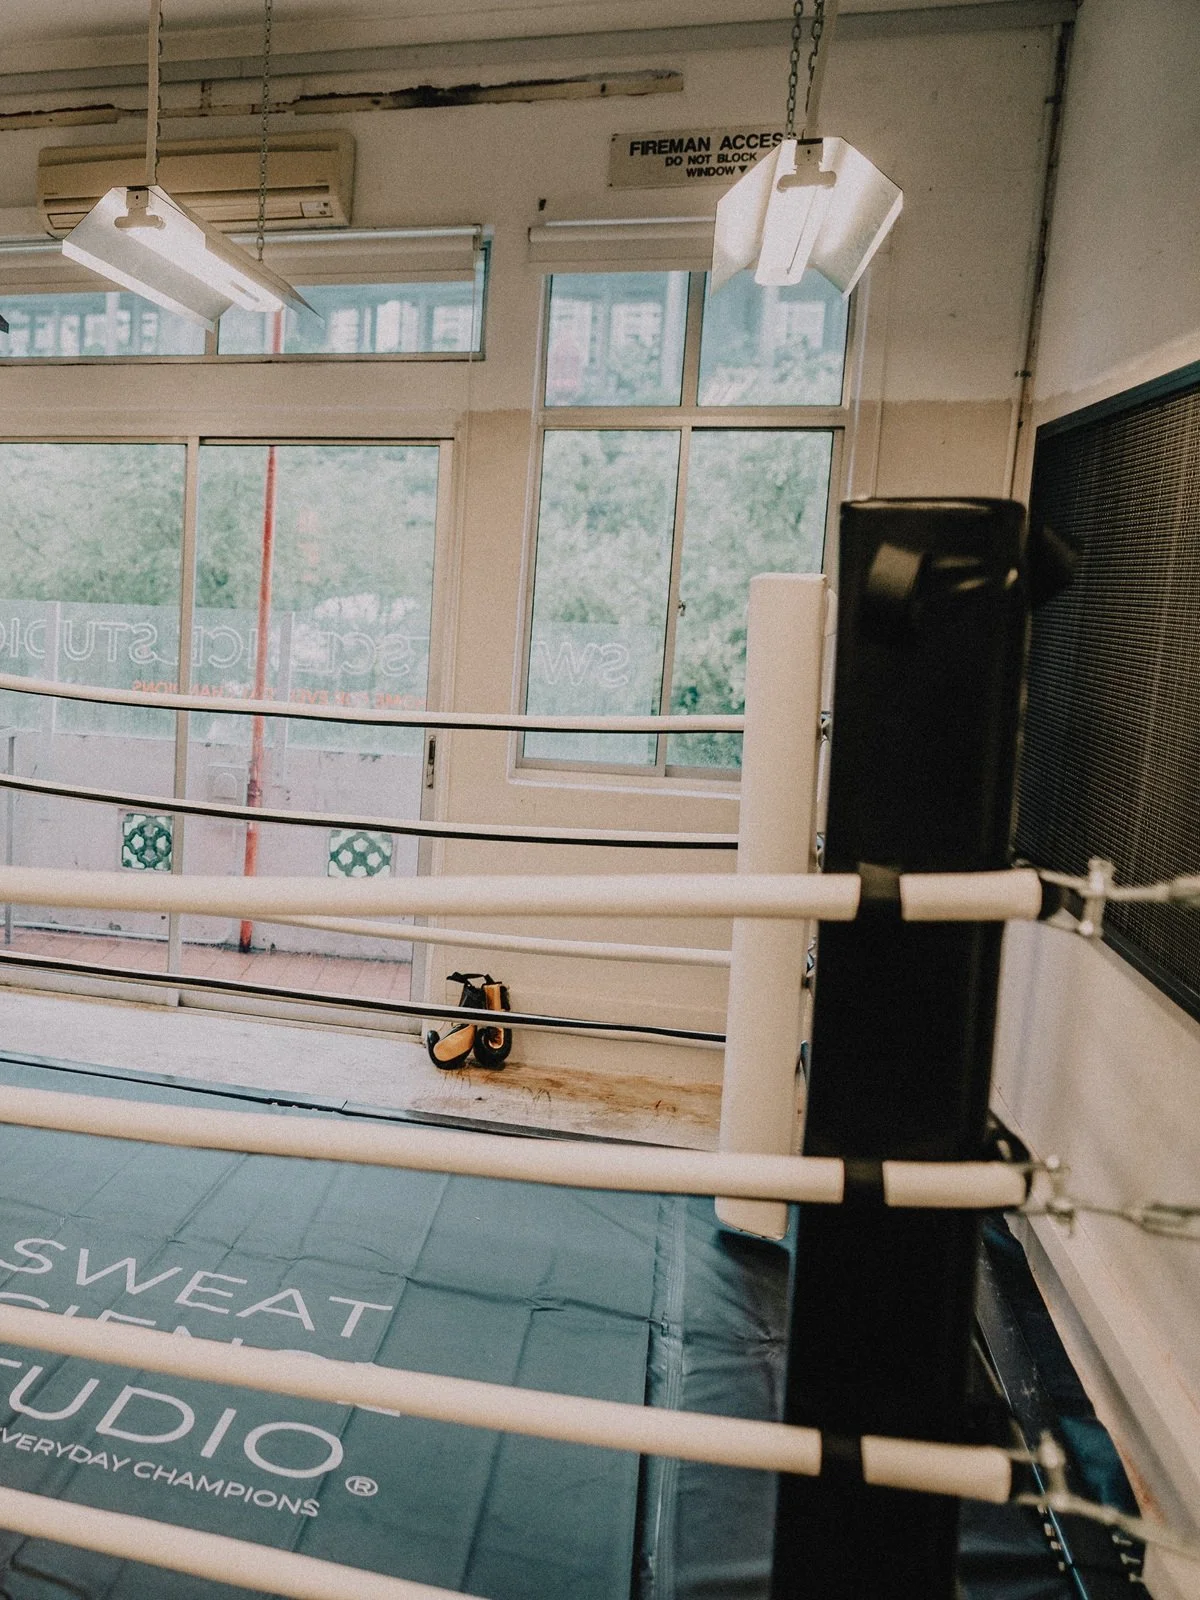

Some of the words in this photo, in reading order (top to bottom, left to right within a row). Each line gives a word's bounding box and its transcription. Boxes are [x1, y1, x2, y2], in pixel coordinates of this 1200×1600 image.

[629, 136, 711, 156] FIREMAN
[719, 132, 796, 151] ACCES
[665, 155, 683, 167] DO
[687, 154, 711, 165] NOT
[717, 152, 757, 164] BLOCK
[686, 166, 736, 177] WINDOW
[133, 1461, 321, 1519] CHAMPIONS
